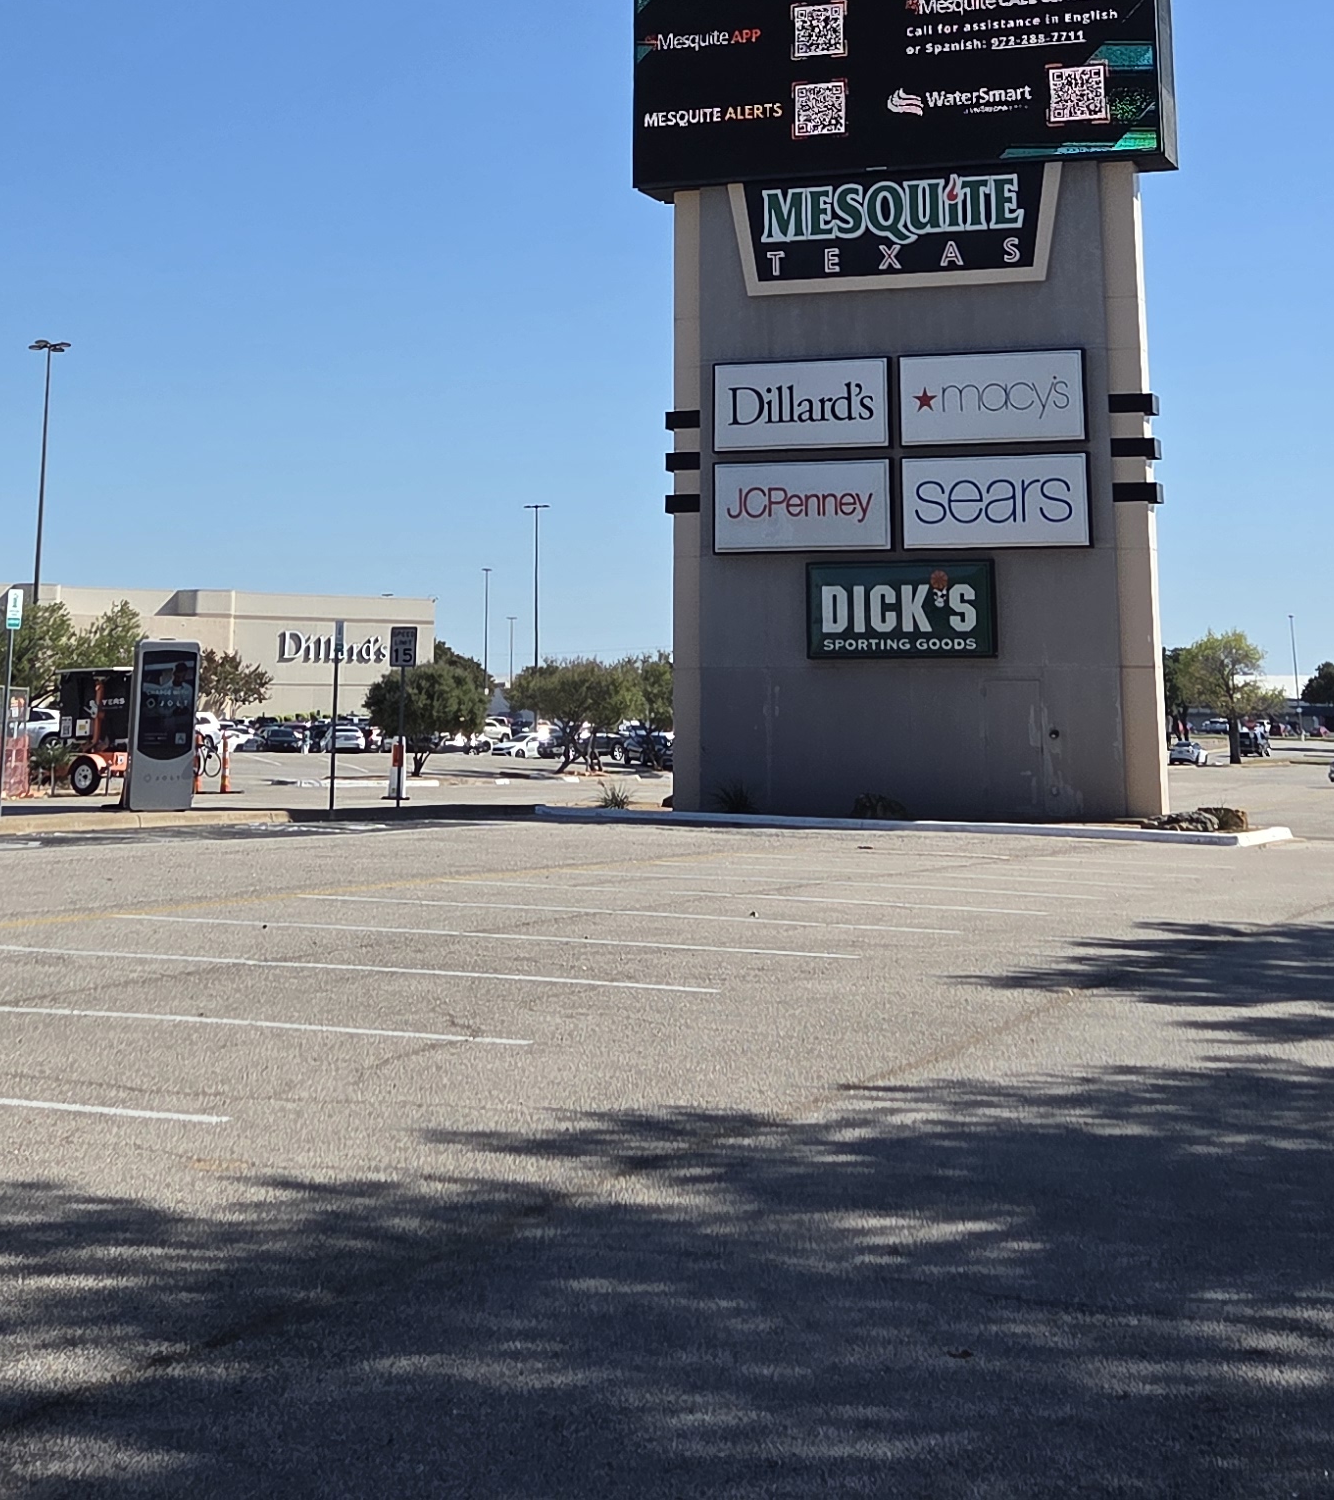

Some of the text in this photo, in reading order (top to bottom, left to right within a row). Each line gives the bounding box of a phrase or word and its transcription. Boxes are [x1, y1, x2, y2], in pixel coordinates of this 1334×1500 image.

[730, 28, 761, 44] APP
[907, 8, 1118, 37] Call for assistance in English
[906, 46, 921, 55] or
[925, 39, 987, 55] Spanish:
[925, 84, 1033, 107] WaterSmart
[644, 102, 783, 127] MESQUITE ALERTS
[767, 237, 1021, 276] TEXAS
[727, 381, 874, 426] Dillard's
[941, 376, 1070, 419] macy's
[727, 487, 873, 523] JCPenney
[915, 478, 1073, 524] sears
[822, 583, 977, 633] DICK'S
[394, 647, 413, 663] 15
[823, 638, 977, 651] SPORTING GOODS
